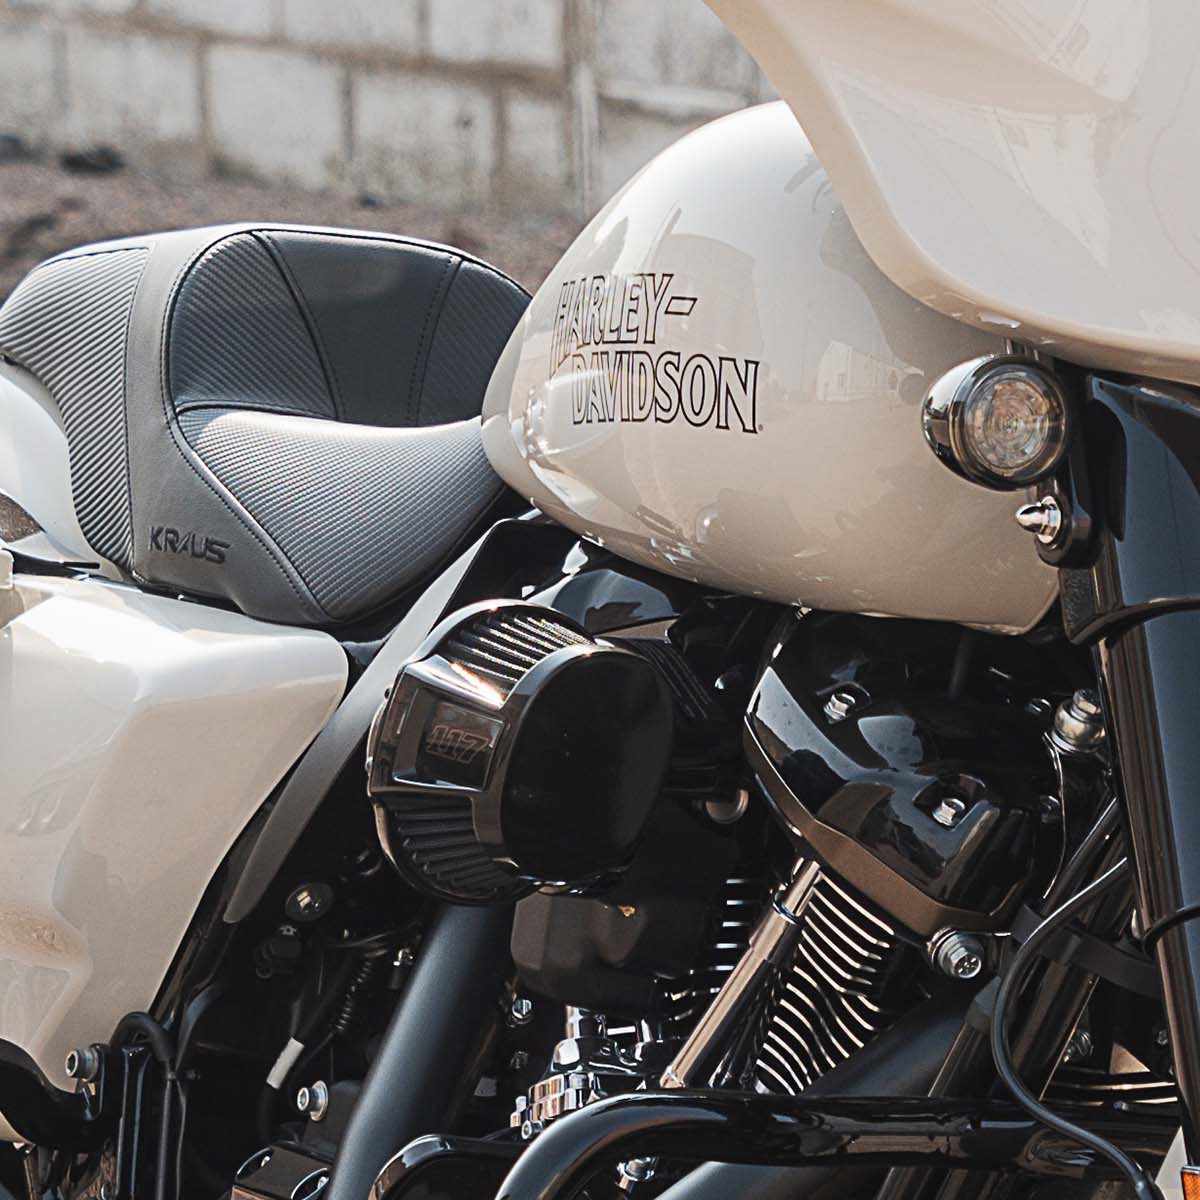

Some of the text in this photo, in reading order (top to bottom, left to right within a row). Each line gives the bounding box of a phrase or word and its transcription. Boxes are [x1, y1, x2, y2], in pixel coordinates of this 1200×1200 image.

[550, 273, 698, 379] HARLEY-
[572, 350, 760, 434] DAVIDSON
[148, 526, 231, 564] KRAUS
[427, 724, 489, 764] 117
